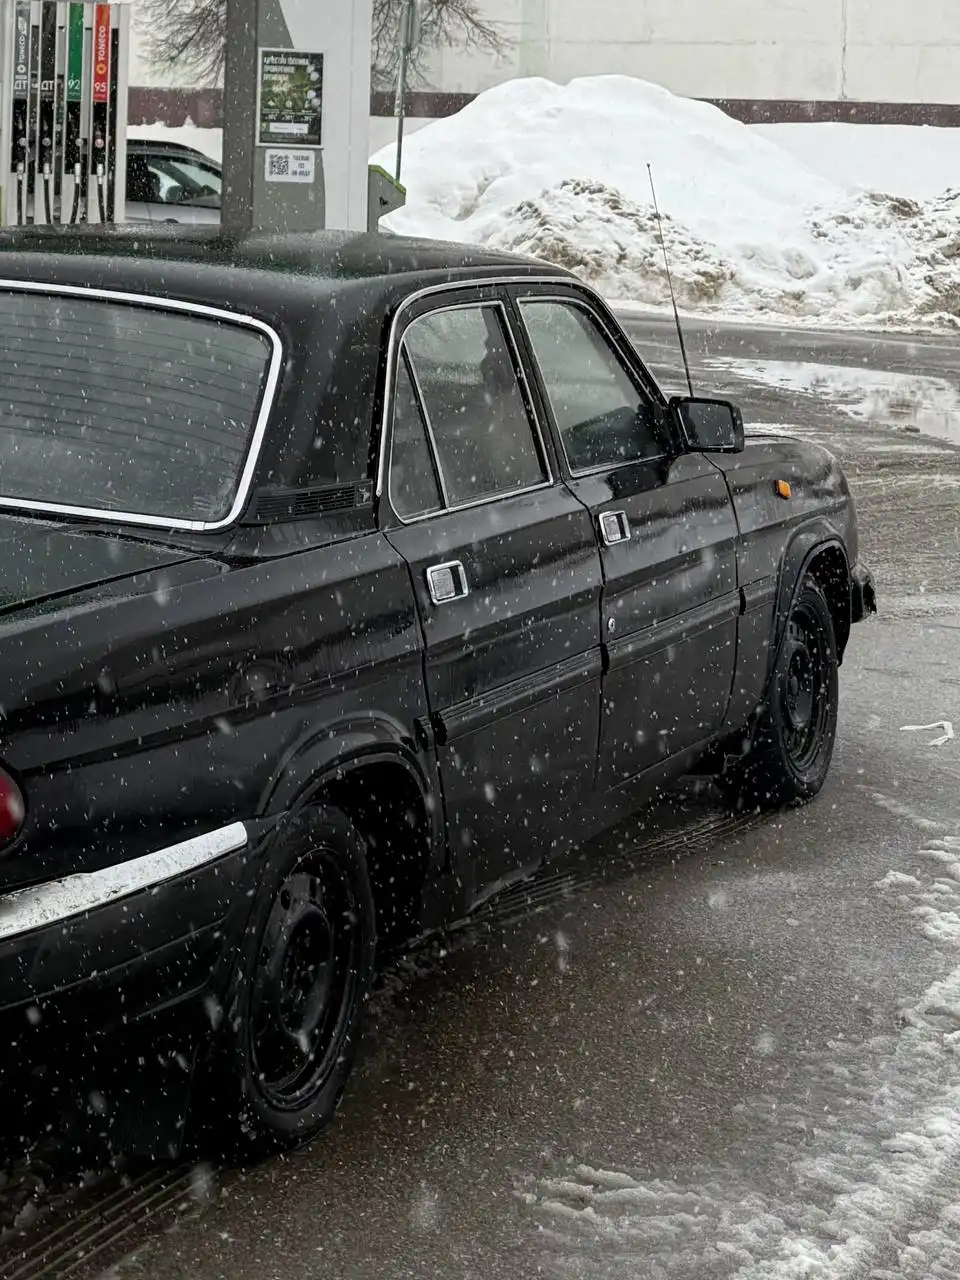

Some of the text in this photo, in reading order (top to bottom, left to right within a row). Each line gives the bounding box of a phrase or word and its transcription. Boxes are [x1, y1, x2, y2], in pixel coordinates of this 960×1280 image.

[14, 80, 27, 91] ДТ
[41, 80, 54, 91] ДТ
[68, 79, 80, 90] 92
[94, 81, 107, 92] 95
